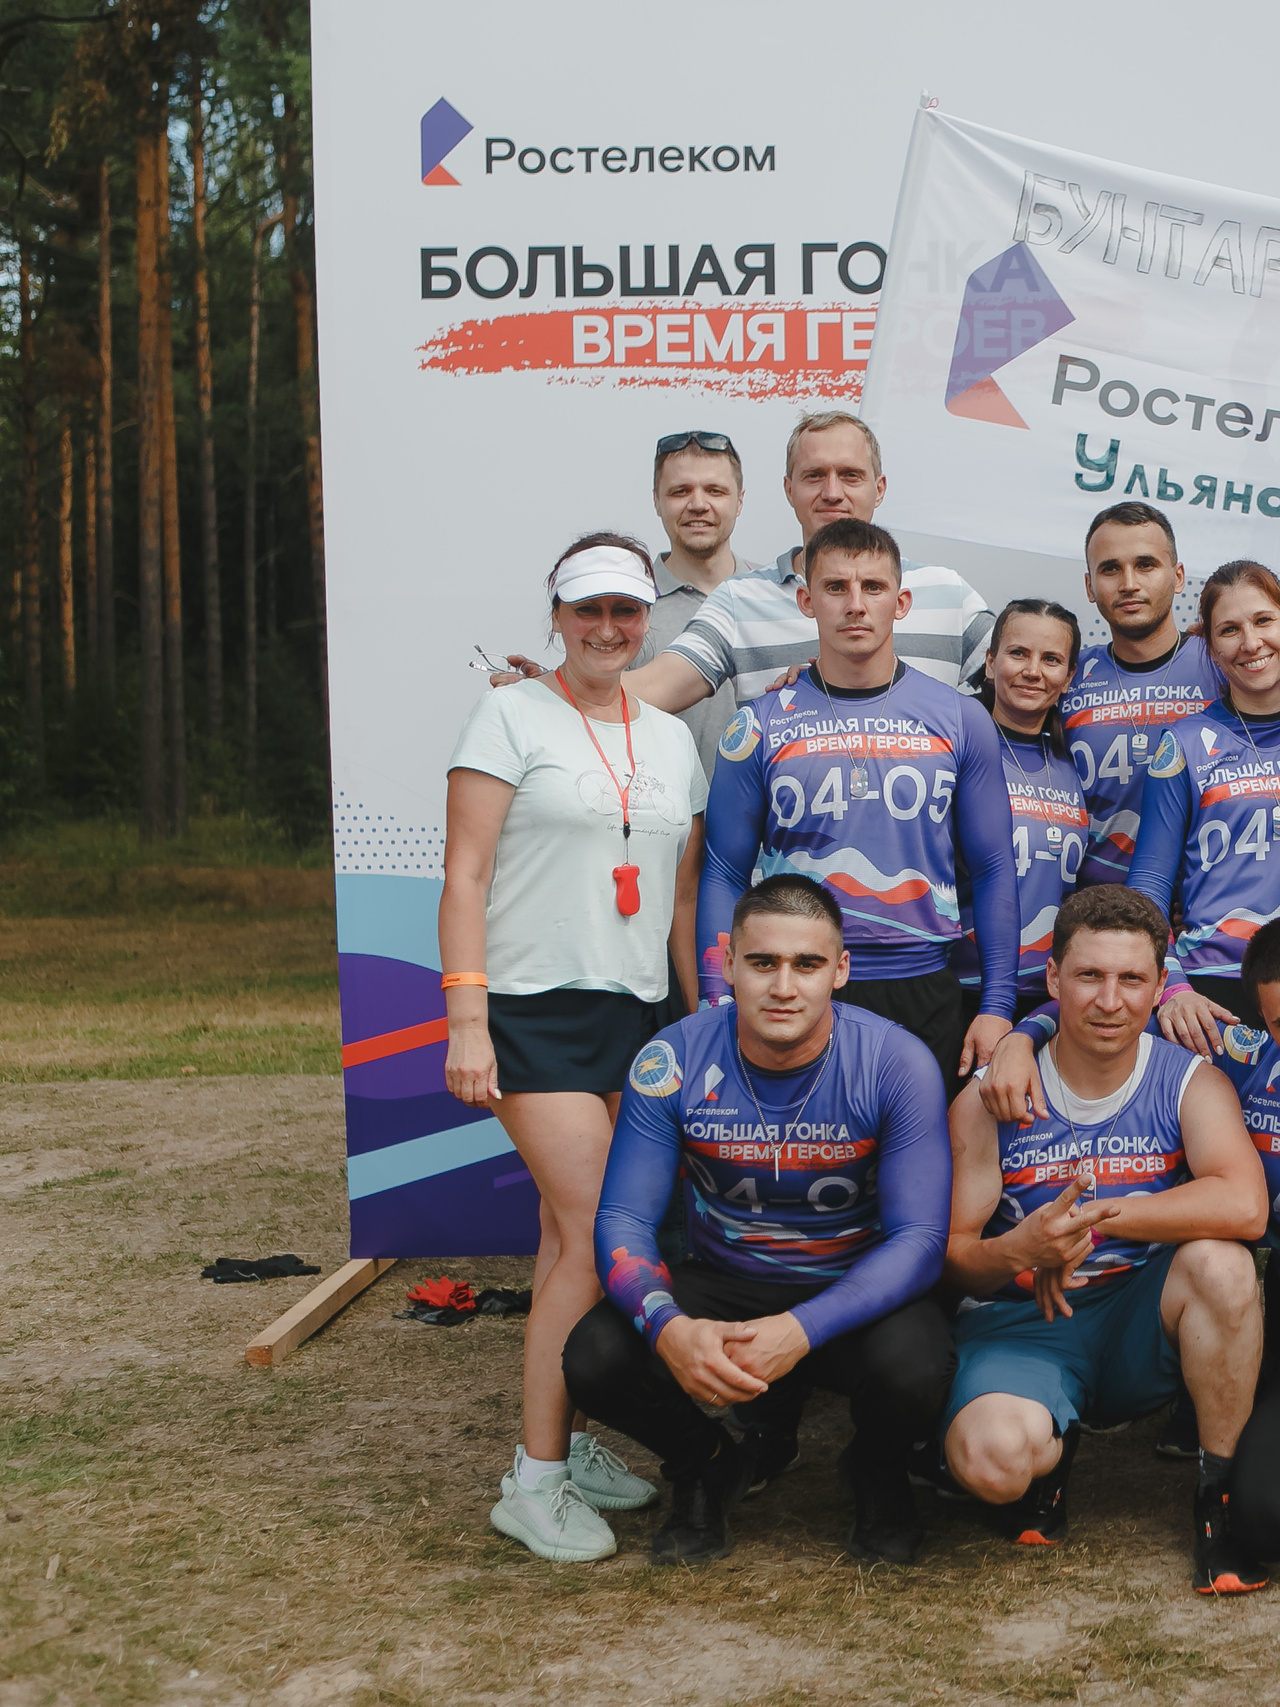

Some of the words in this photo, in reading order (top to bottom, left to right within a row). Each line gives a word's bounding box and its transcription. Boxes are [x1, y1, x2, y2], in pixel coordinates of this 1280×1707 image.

[484, 138, 775, 174] Ростелеком
[420, 242, 776, 299] БОЛЬШАЯ
[571, 312, 786, 365] ВРЕМЯ
[1061, 686, 1143, 714] БОЛЬШАЯ
[1145, 685, 1204, 701] ГОНКА
[1092, 703, 1142, 723] ВРЕМЯ
[1146, 702, 1206, 716] ГЕРОЕВ
[768, 717, 860, 749] БОЛЬШАЯ
[864, 718, 929, 735] ГОНКА
[806, 735, 863, 753] ВРЕМЯ
[866, 735, 932, 751] ГЕРОЕВ
[1070, 733, 1155, 791] 04-
[1196, 755, 1239, 774] Ростком
[770, 764, 957, 829] 04-05
[1037, 786, 1080, 806] ГОНКА
[1228, 777, 1280, 796] ВРЕМЯ
[1043, 801, 1082, 821] ГЕРОЕ
[785, 1123, 851, 1141] ГОНКА
[718, 1144, 781, 1160] ВРЕМЯ
[787, 1143, 857, 1161] ГЕРОЕВ
[1097, 1136, 1163, 1154] ГОНКА
[1034, 1158, 1094, 1183] ВРЕМЯ
[1098, 1156, 1167, 1174] ГЕРОЕВ
